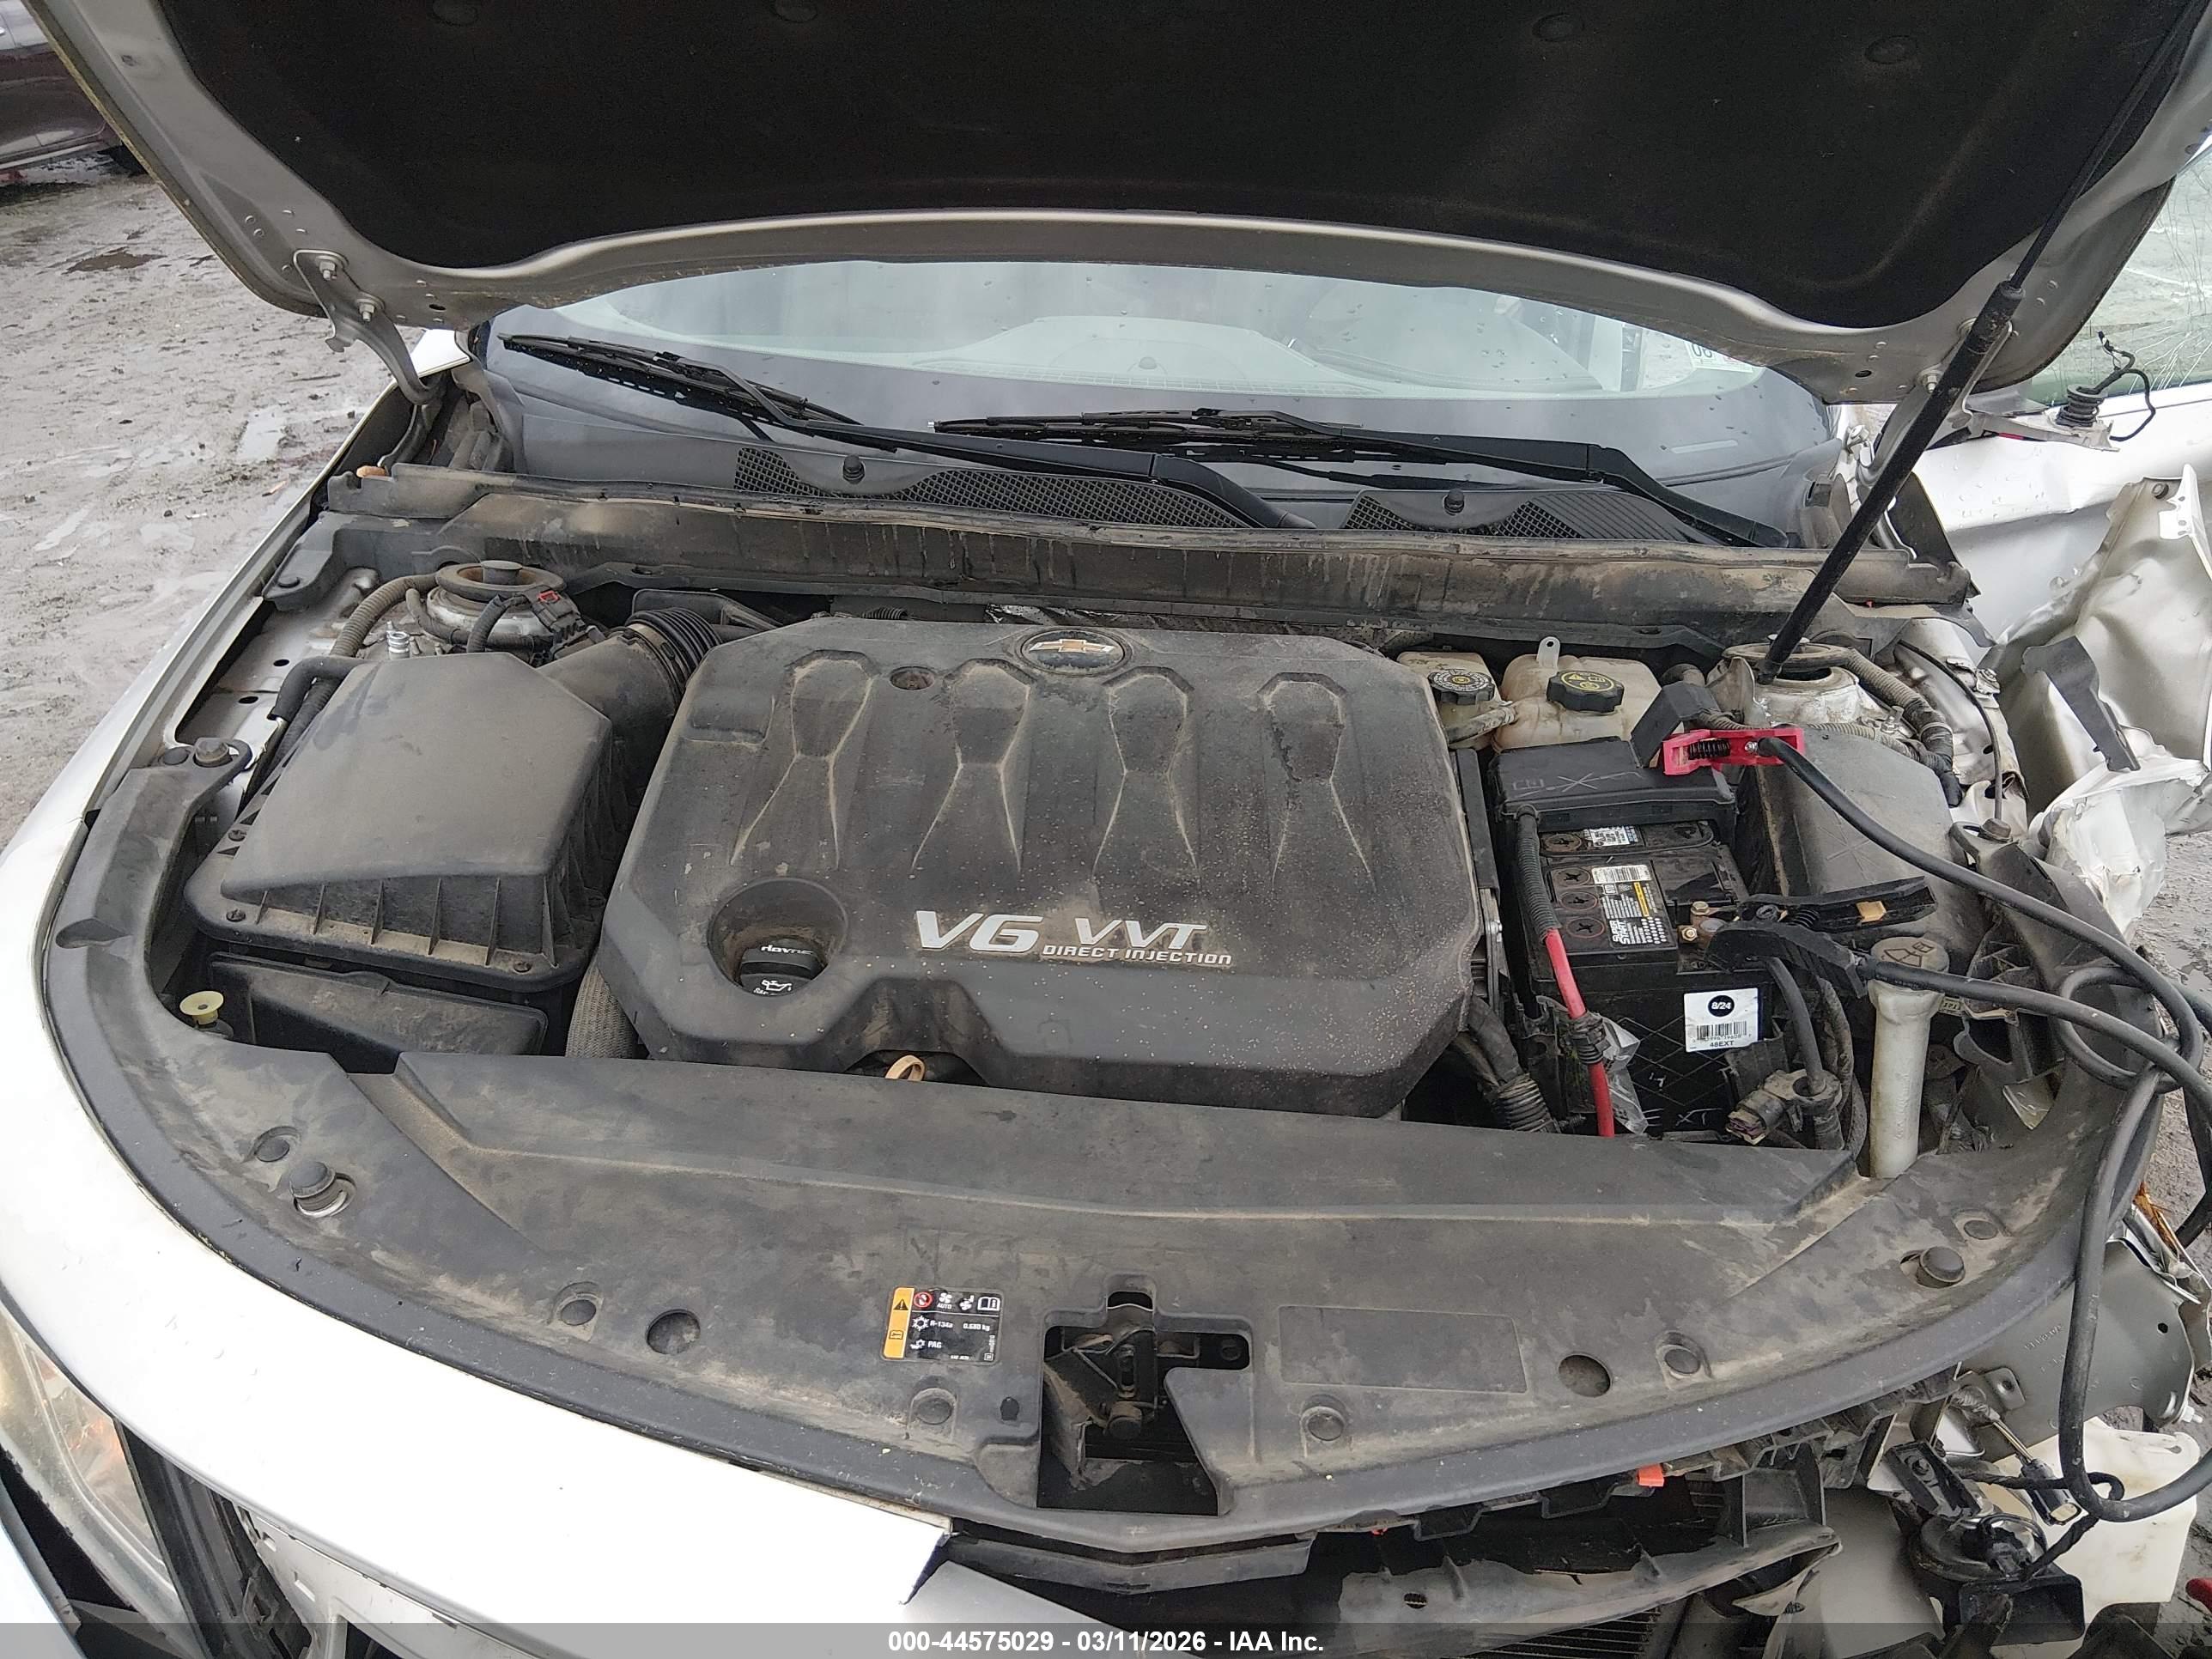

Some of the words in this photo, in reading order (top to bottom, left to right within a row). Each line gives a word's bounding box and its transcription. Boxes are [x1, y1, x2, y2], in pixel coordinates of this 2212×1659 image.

[915, 910, 1044, 952] V6
[1074, 917, 1207, 950] VVT
[1042, 945, 1120, 958] DIRECT
[1124, 949, 1233, 964] INJECTION
[1711, 1001, 1732, 1010] 8/24
[929, 1320, 953, 1328] R-134a
[927, 1340, 942, 1349] PAG
